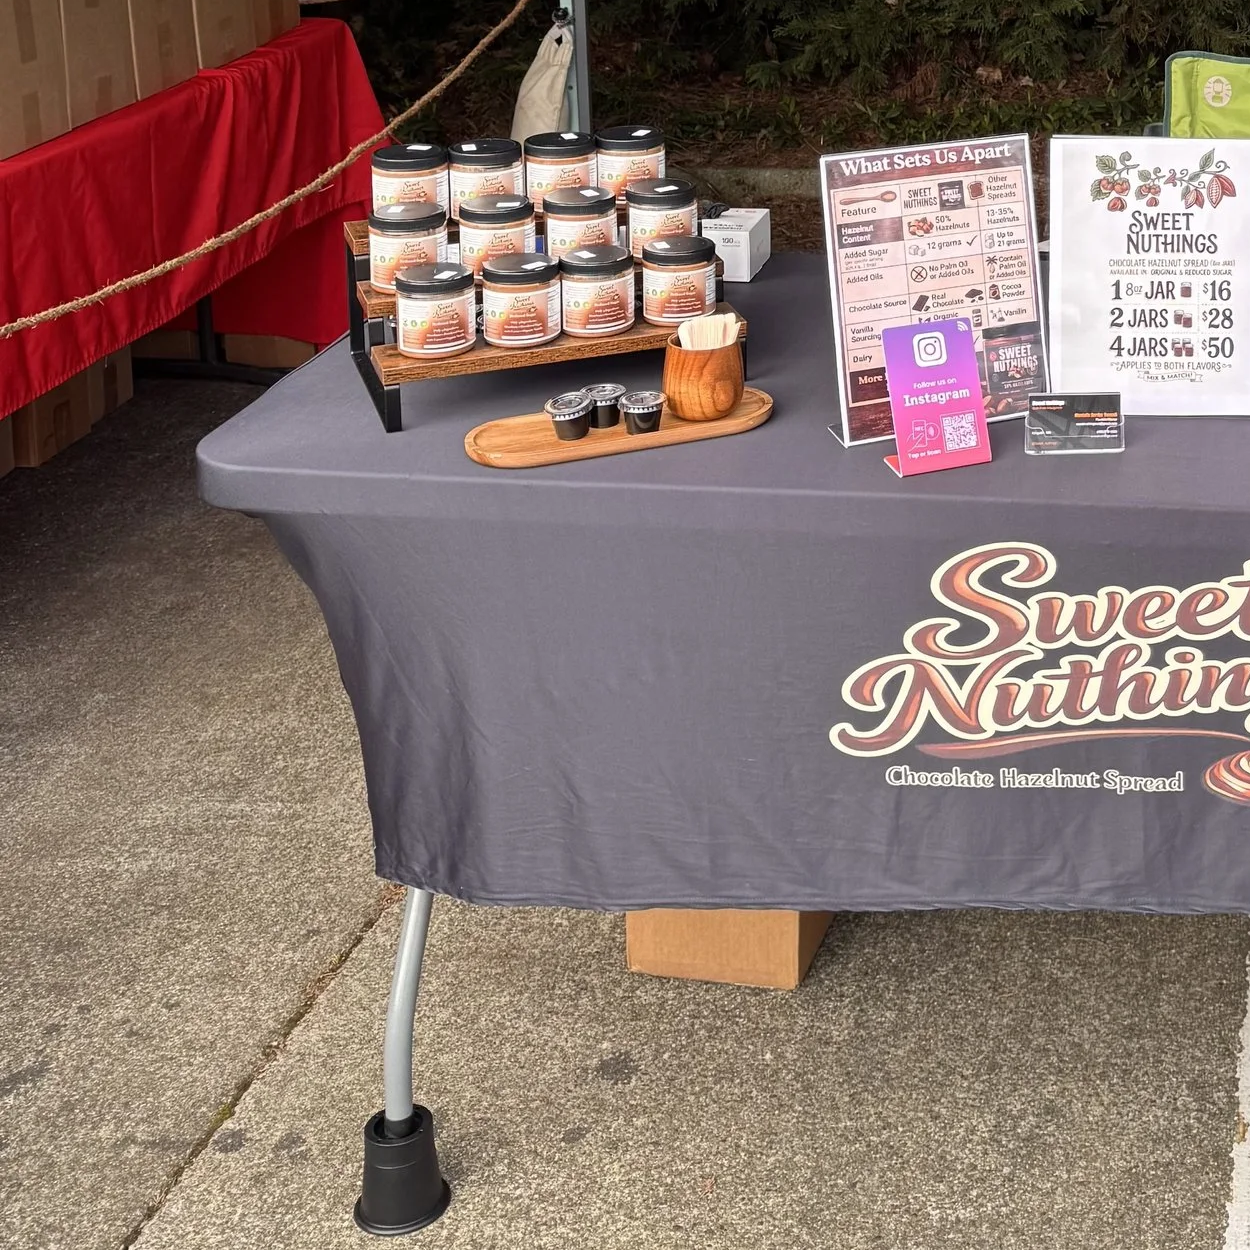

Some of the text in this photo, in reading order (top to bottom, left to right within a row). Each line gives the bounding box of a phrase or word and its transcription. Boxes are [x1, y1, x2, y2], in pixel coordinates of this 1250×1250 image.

[839, 143, 1011, 176] What Sets Us Apart
[988, 175, 1007, 183] Other
[986, 182, 1017, 192] Hazelnut
[908, 187, 931, 198] SWEET
[988, 191, 1016, 200] Spreads
[903, 197, 938, 209] NUTHINGS
[841, 206, 877, 217] Feature
[935, 216, 951, 224] 50%
[987, 216, 1019, 225] Hazelnuts
[1129, 210, 1194, 234] SWEET
[842, 225, 874, 235] Hazelnut
[935, 222, 970, 232] Hazelnuts
[842, 234, 871, 244] Content
[937, 239, 962, 249] grams
[1006, 238, 1025, 247] grams
[1127, 232, 1218, 254] NUTHINGS
[844, 248, 888, 260] Added Sugar
[1000, 262, 1016, 270] Palm
[1109, 259, 1146, 267] CHOCOLATE
[1148, 259, 1181, 267] HAZELNUT
[1183, 259, 1208, 267] SPREAD
[846, 273, 883, 284] Added Oils
[939, 269, 960, 278] Added
[1002, 290, 1025, 298] Powder
[1111, 279, 1122, 300] 1
[1144, 280, 1176, 300] JAR
[1202, 279, 1232, 301] $16
[849, 299, 907, 313] Chocolate Source
[932, 298, 964, 309] Chocolate
[933, 312, 959, 321] Organic
[1110, 307, 1234, 329] 2 JARS $28
[850, 326, 874, 335] Vanilla
[851, 334, 881, 343] Sourcing
[1109, 335, 1235, 358] 4 JARS $50
[998, 344, 1032, 360] SWEET
[853, 355, 873, 363] Dairy
[993, 355, 1039, 373] NUTHINGS
[1119, 361, 1221, 372] APPLIES TO BOTH FLAVORS
[858, 375, 883, 385] More
[1167, 372, 1193, 380] MATCH!
[913, 380, 936, 389] Follow
[903, 388, 970, 407] Instagram
[885, 766, 1184, 794] Chocolate Hazelnut Spread
